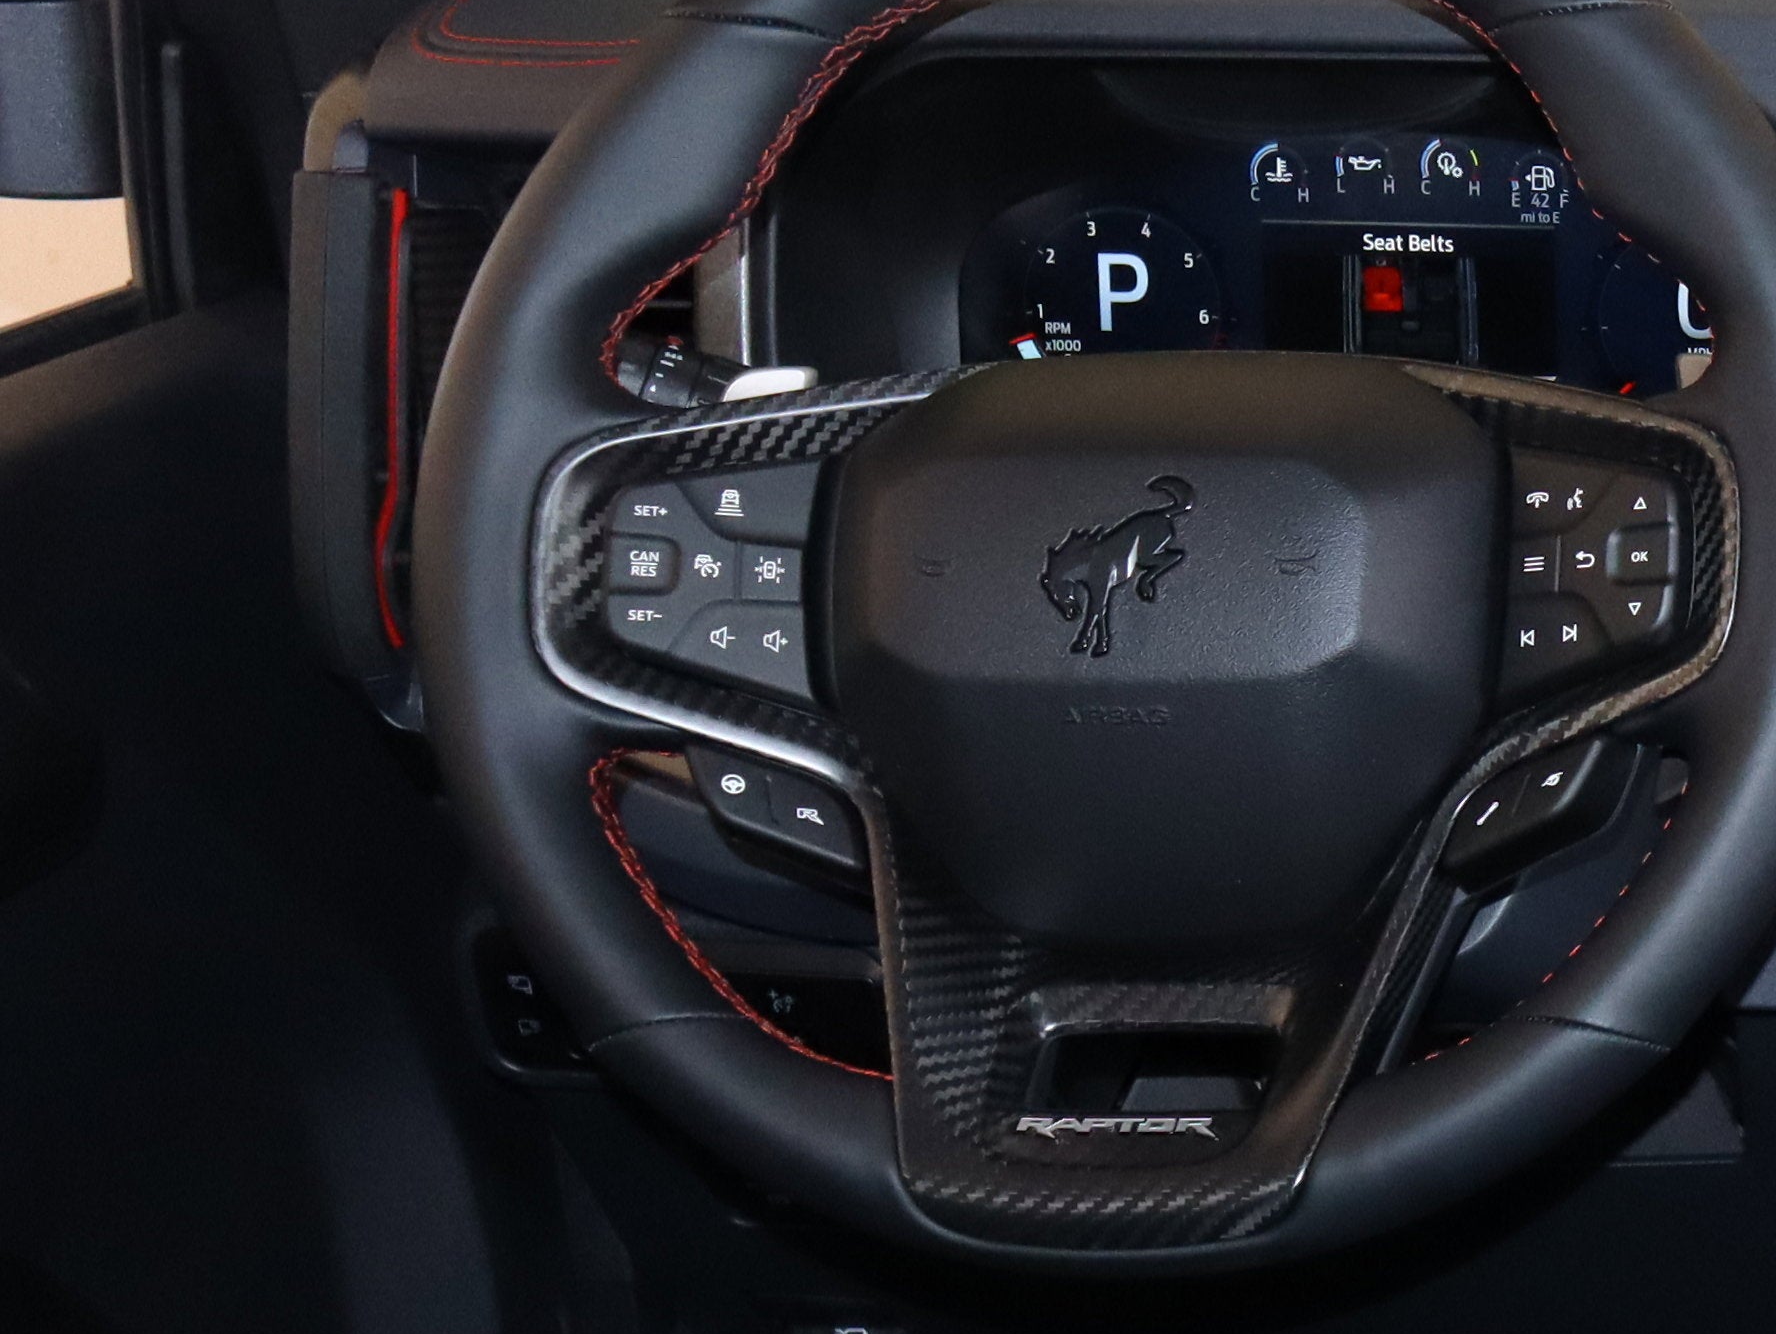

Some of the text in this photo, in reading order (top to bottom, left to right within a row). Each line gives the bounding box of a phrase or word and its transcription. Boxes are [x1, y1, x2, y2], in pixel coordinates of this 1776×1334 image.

[1336, 178, 1345, 193] L
[1384, 179, 1395, 194] H
[1420, 180, 1431, 195] C
[1469, 180, 1480, 196] H
[1250, 187, 1260, 202] C
[1298, 187, 1309, 202] H
[1511, 193, 1520, 207] E
[1530, 193, 1550, 208] 42
[1560, 193, 1569, 208] F
[1520, 213, 1535, 223] mi
[1538, 212, 1551, 223] to
[1086, 221, 1096, 236] 3
[1141, 223, 1151, 238] 4
[1363, 233, 1454, 253] Seat Belts
[1046, 248, 1056, 264] 2
[1184, 253, 1194, 268] 5
[1097, 252, 1149, 331] P
[1037, 303, 1044, 318] 1
[1199, 309, 1209, 324] 6
[1045, 321, 1071, 334] RPM
[1045, 339, 1081, 352] x1000
[634, 504, 668, 517] SET+
[629, 550, 660, 565] CAN
[1630, 551, 1649, 563] OK
[631, 564, 657, 577] RES
[1016, 1117, 1219, 1142] RAPTOR
